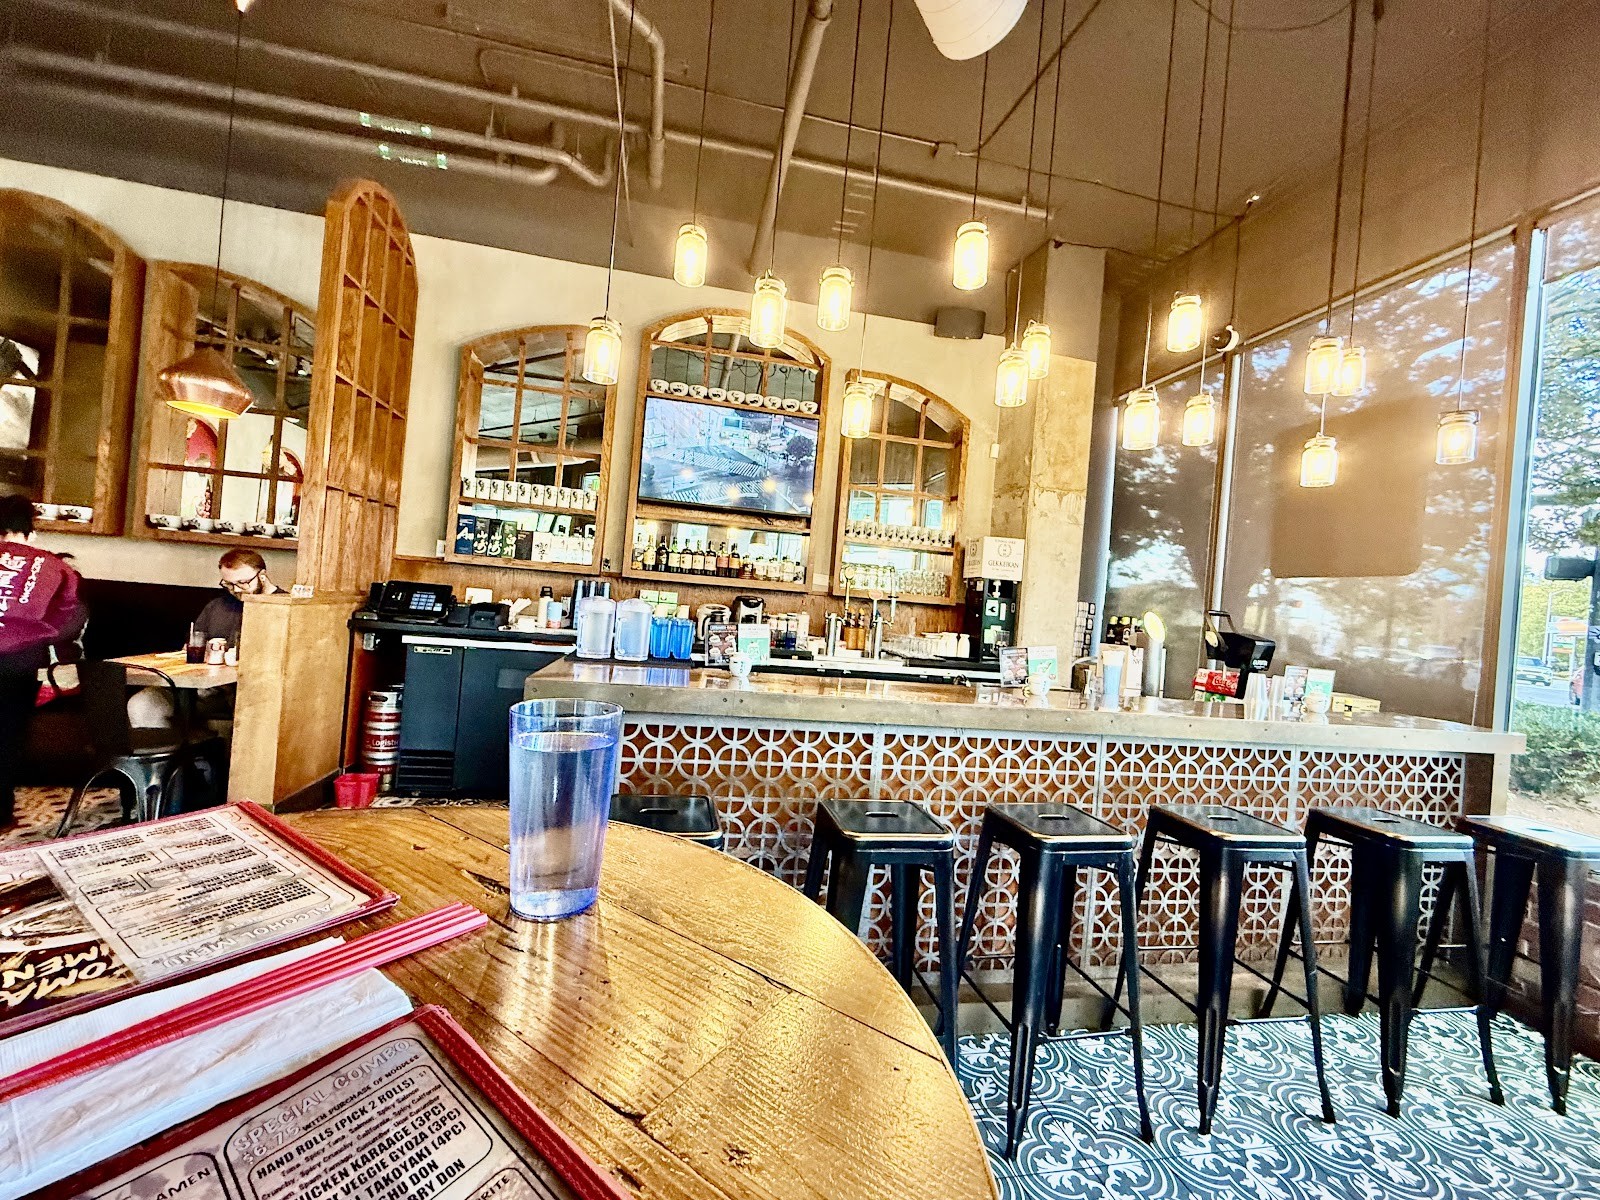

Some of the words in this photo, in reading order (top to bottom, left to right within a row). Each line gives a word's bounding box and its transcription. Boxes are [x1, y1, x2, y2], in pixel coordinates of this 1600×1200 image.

[240, 903, 333, 939] ALCOHOL
[162, 937, 239, 970] MENU
[233, 1088, 332, 1151] SPECIAL
[333, 1040, 411, 1090] COMBO
[243, 1122, 301, 1164] $6.75
[302, 1113, 328, 1132] WITH
[328, 1084, 372, 1115] PURCHASE
[373, 1076, 383, 1086] OF
[385, 1054, 420, 1079] NOODLES
[256, 1151, 294, 1180] HAND
[295, 1127, 334, 1156] ROLLS
[368, 1100, 377, 1111] 2
[350, 1126, 412, 1172] KARAAGE
[155, 1167, 211, 1200] AMEN
[340, 1158, 390, 1196] VEGGIE
[388, 1131, 429, 1162] GYOZA
[364, 1145, 432, 1199] TAKOYAKI
[408, 1159, 439, 1187] DON
[435, 1158, 466, 1186] DON
[476, 1175, 511, 1200] RITE
